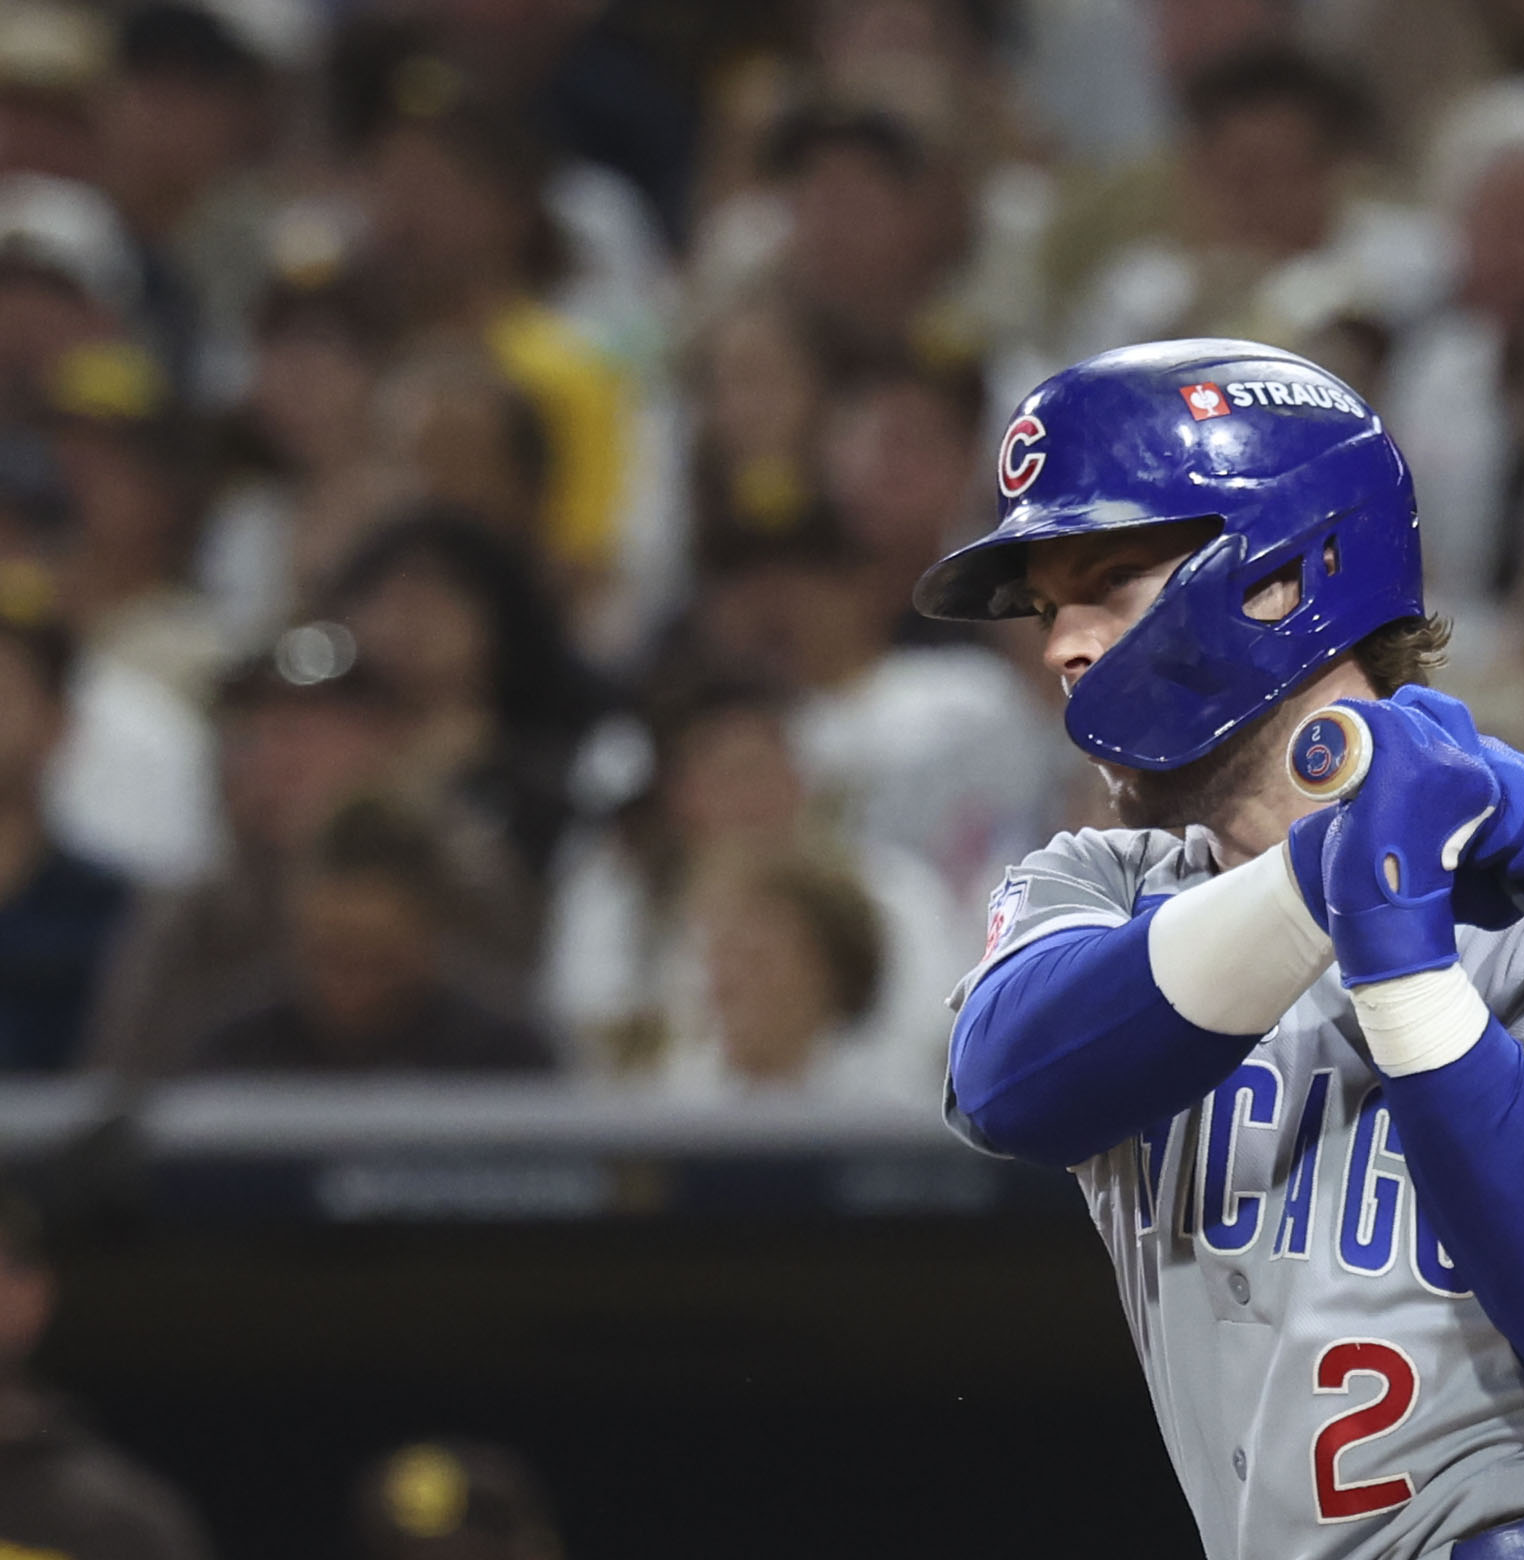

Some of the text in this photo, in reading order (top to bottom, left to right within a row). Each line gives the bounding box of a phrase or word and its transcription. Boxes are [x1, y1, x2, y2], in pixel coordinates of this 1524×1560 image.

[1227, 382, 1365, 419] STRAUSS
[999, 415, 1046, 498] C
[1310, 1336, 1420, 1525] 2
